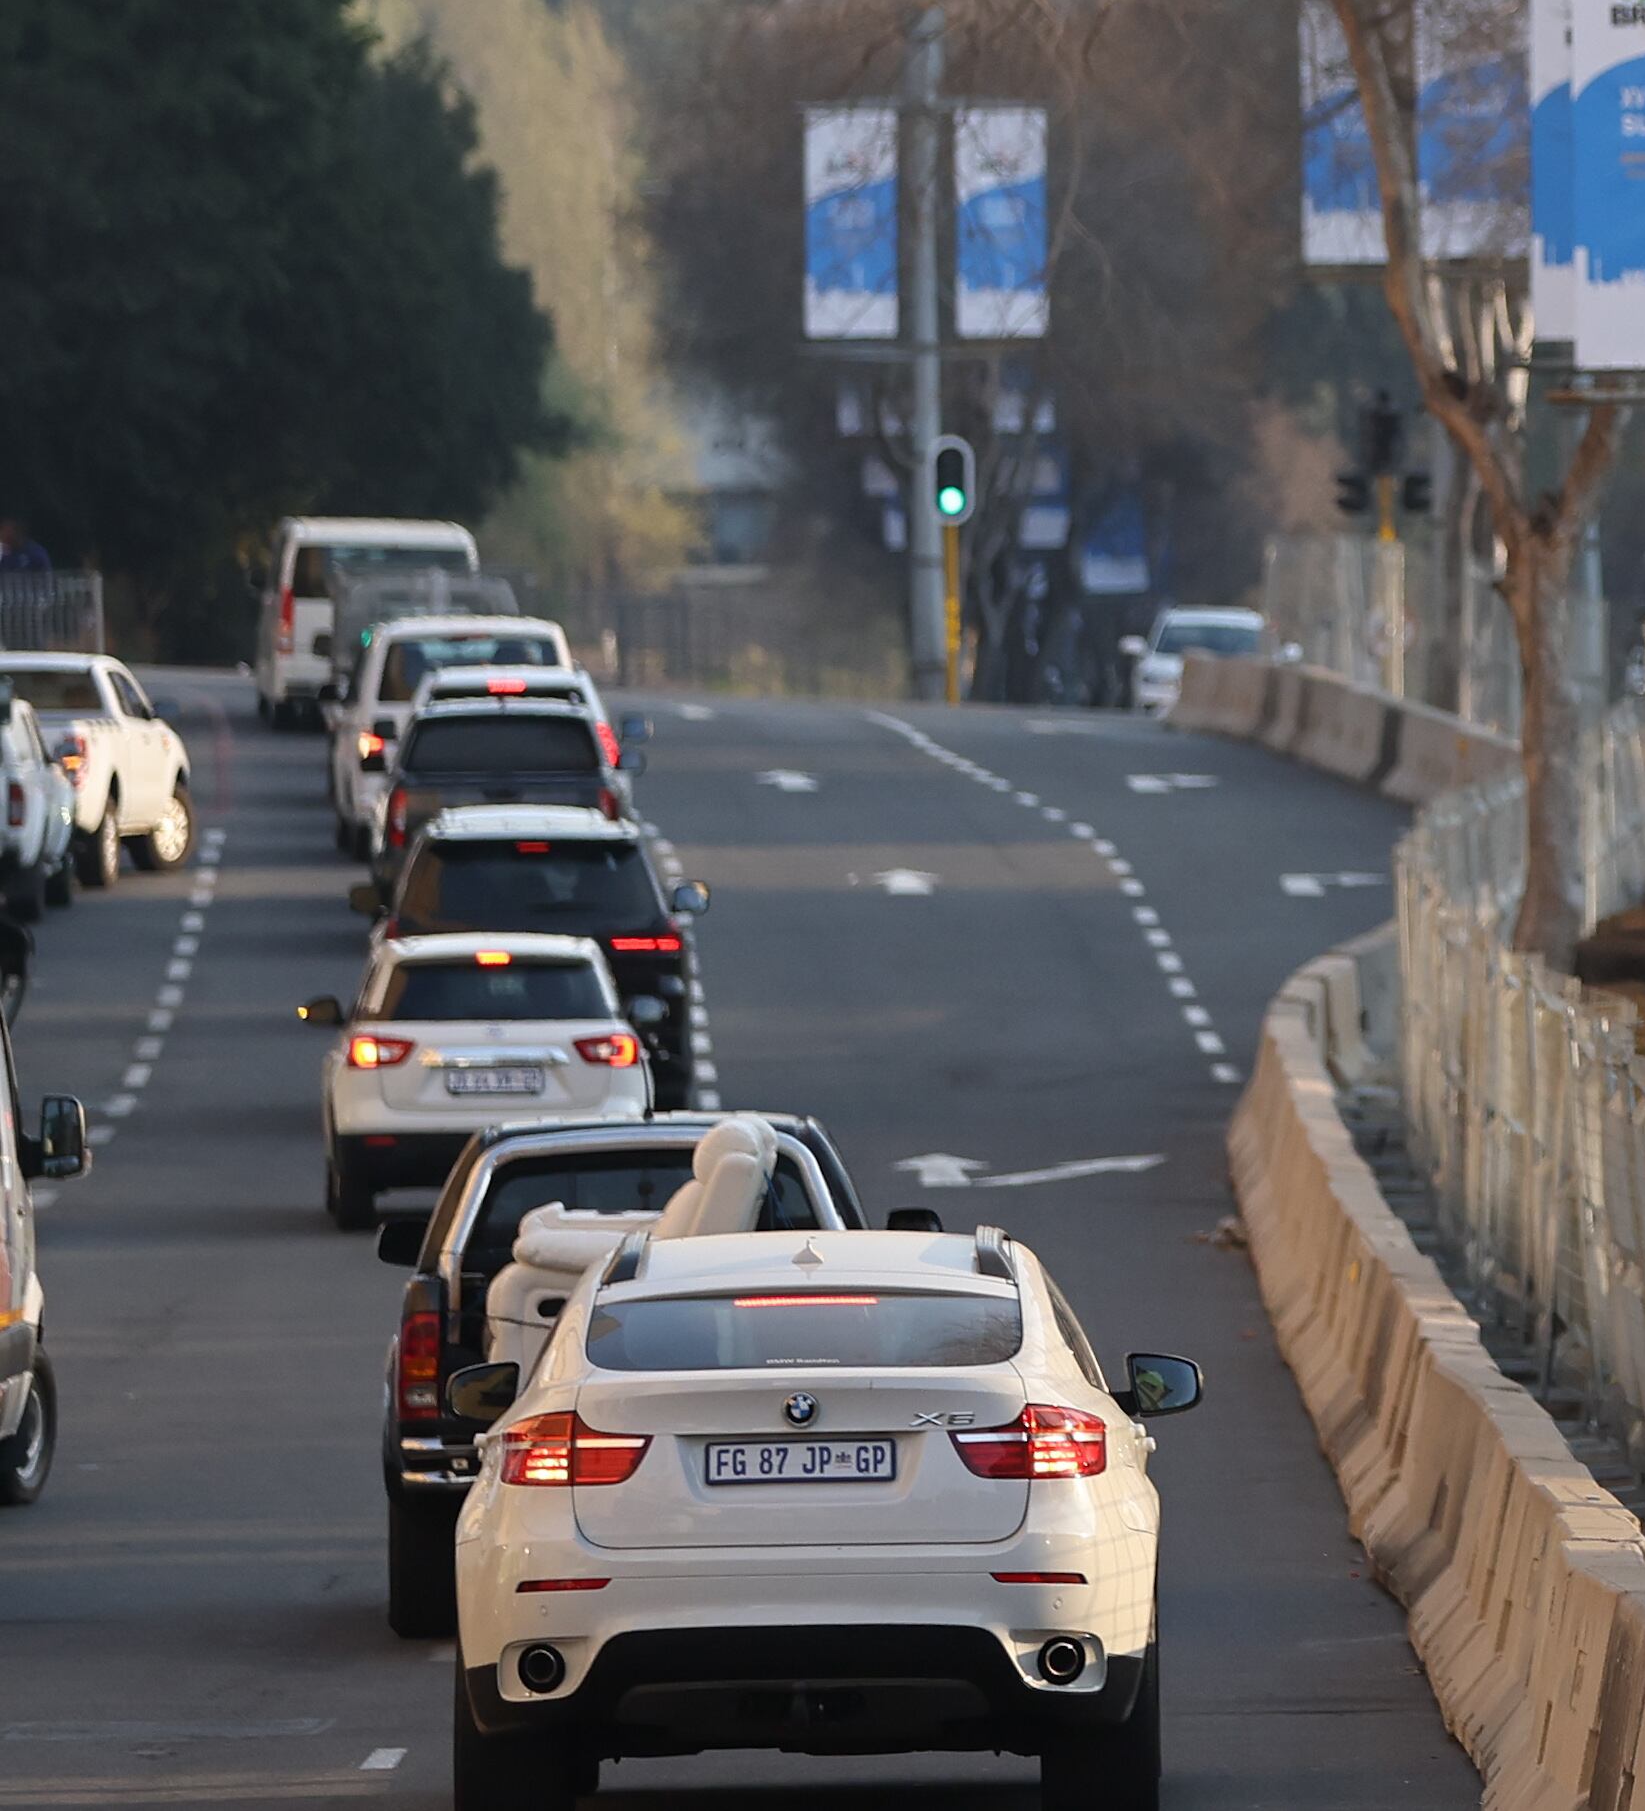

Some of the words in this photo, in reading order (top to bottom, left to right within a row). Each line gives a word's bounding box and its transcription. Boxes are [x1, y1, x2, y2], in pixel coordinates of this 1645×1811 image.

[908, 1410, 976, 1428] X6
[716, 1447, 747, 1476] FG
[759, 1446, 789, 1475] 87
[802, 1445, 831, 1474] JP
[856, 1445, 886, 1473] GP
